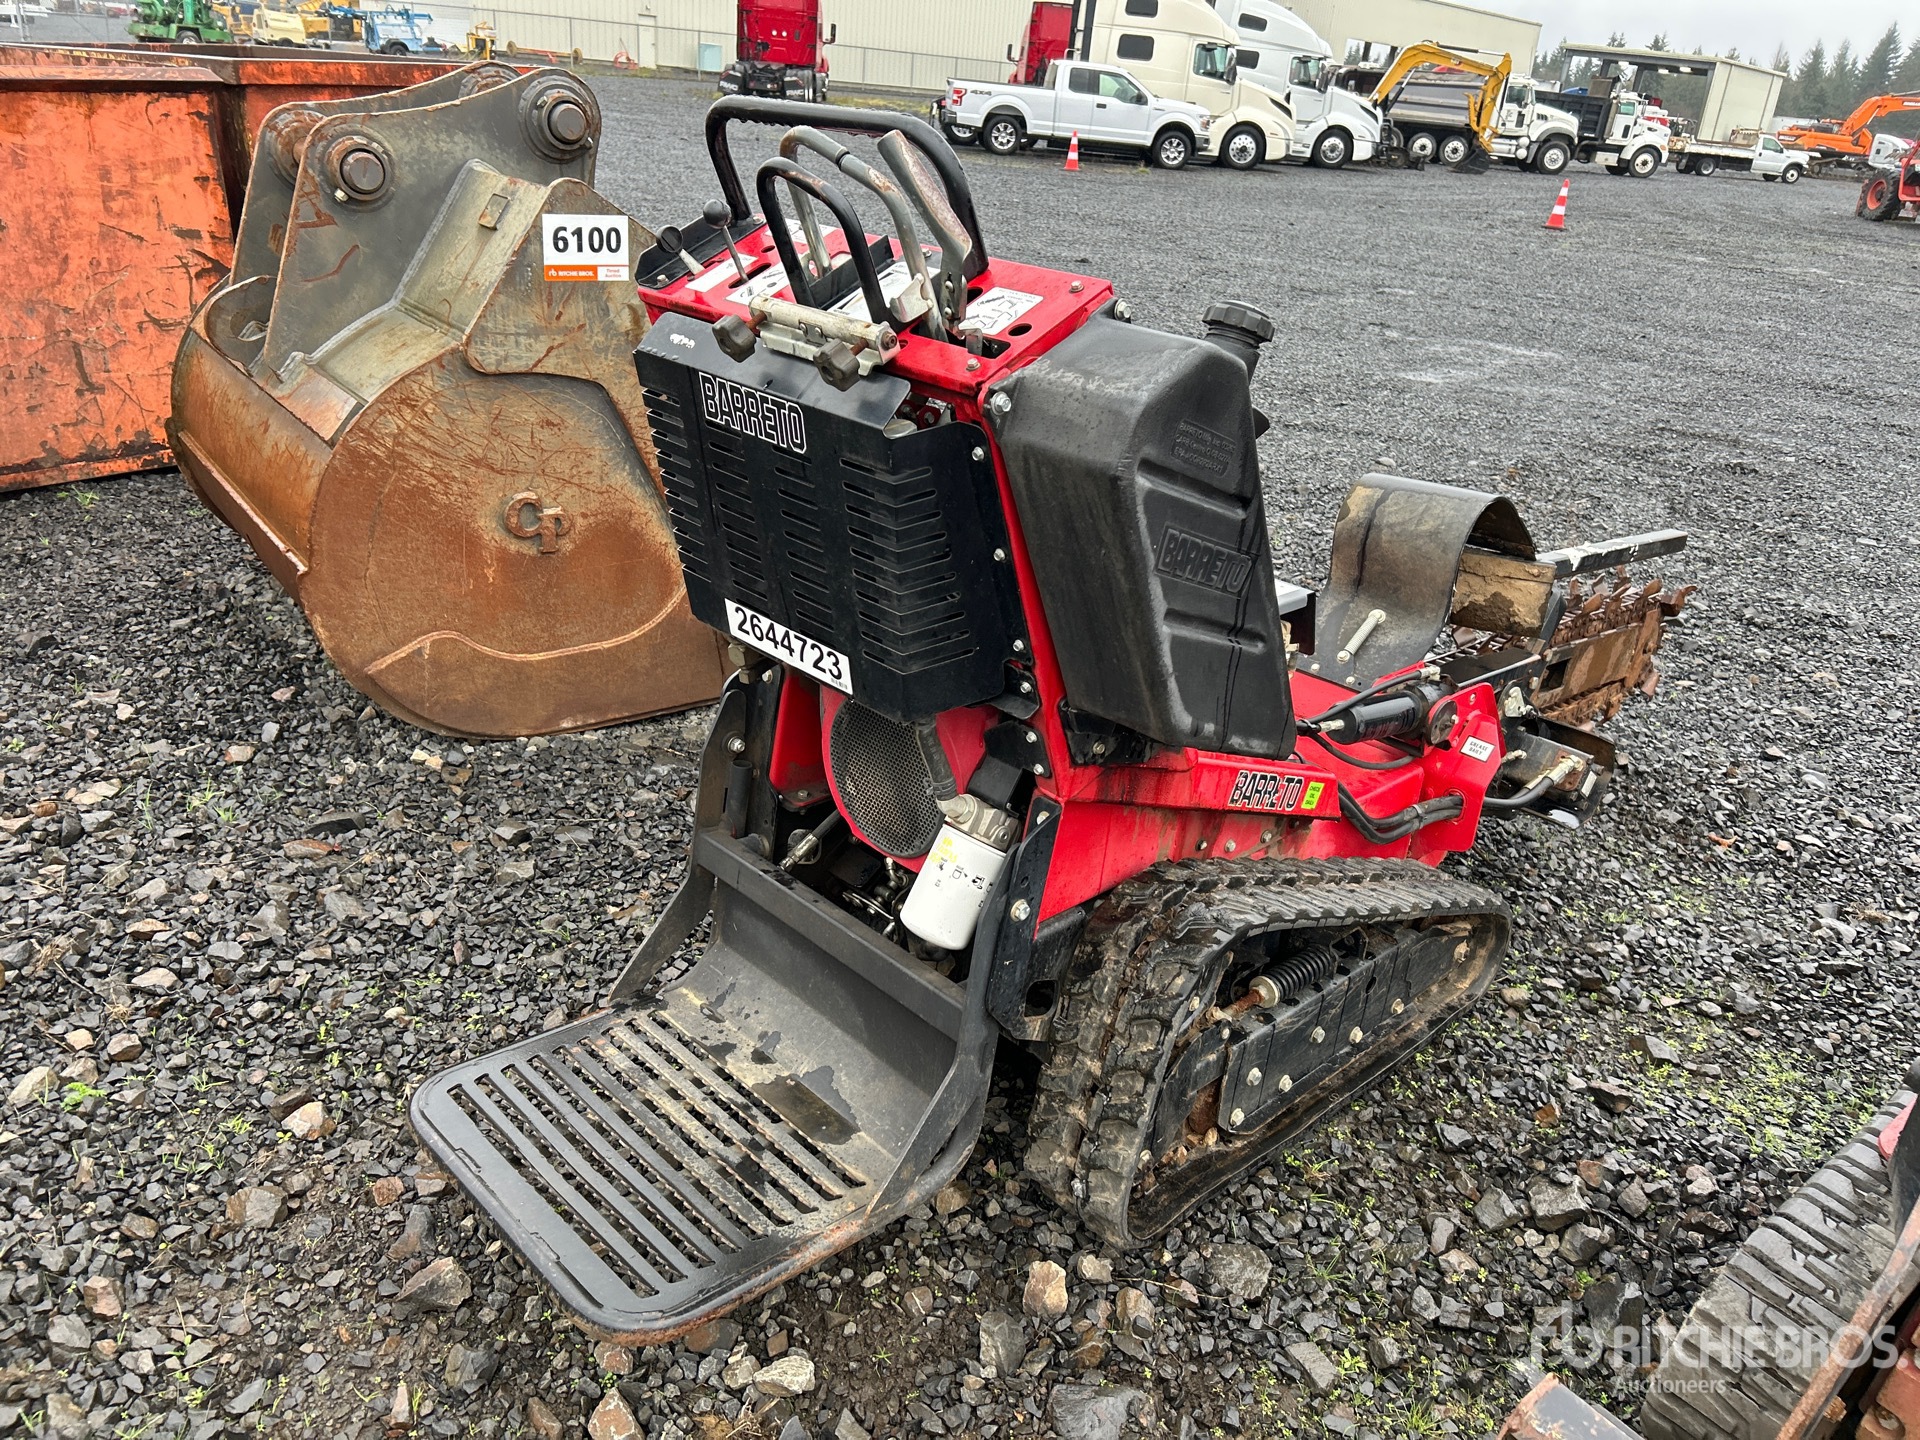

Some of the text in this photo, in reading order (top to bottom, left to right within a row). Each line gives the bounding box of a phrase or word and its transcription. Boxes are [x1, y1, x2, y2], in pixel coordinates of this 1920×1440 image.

[552, 225, 622, 254] 6100
[699, 371, 807, 454] BARRETO
[1158, 528, 1252, 594] BARRETO
[734, 606, 843, 681] 2644723
[1468, 746, 1483, 756] DAILY
[1469, 740, 1489, 752] GREASE
[1227, 769, 1305, 811] BARRETO
